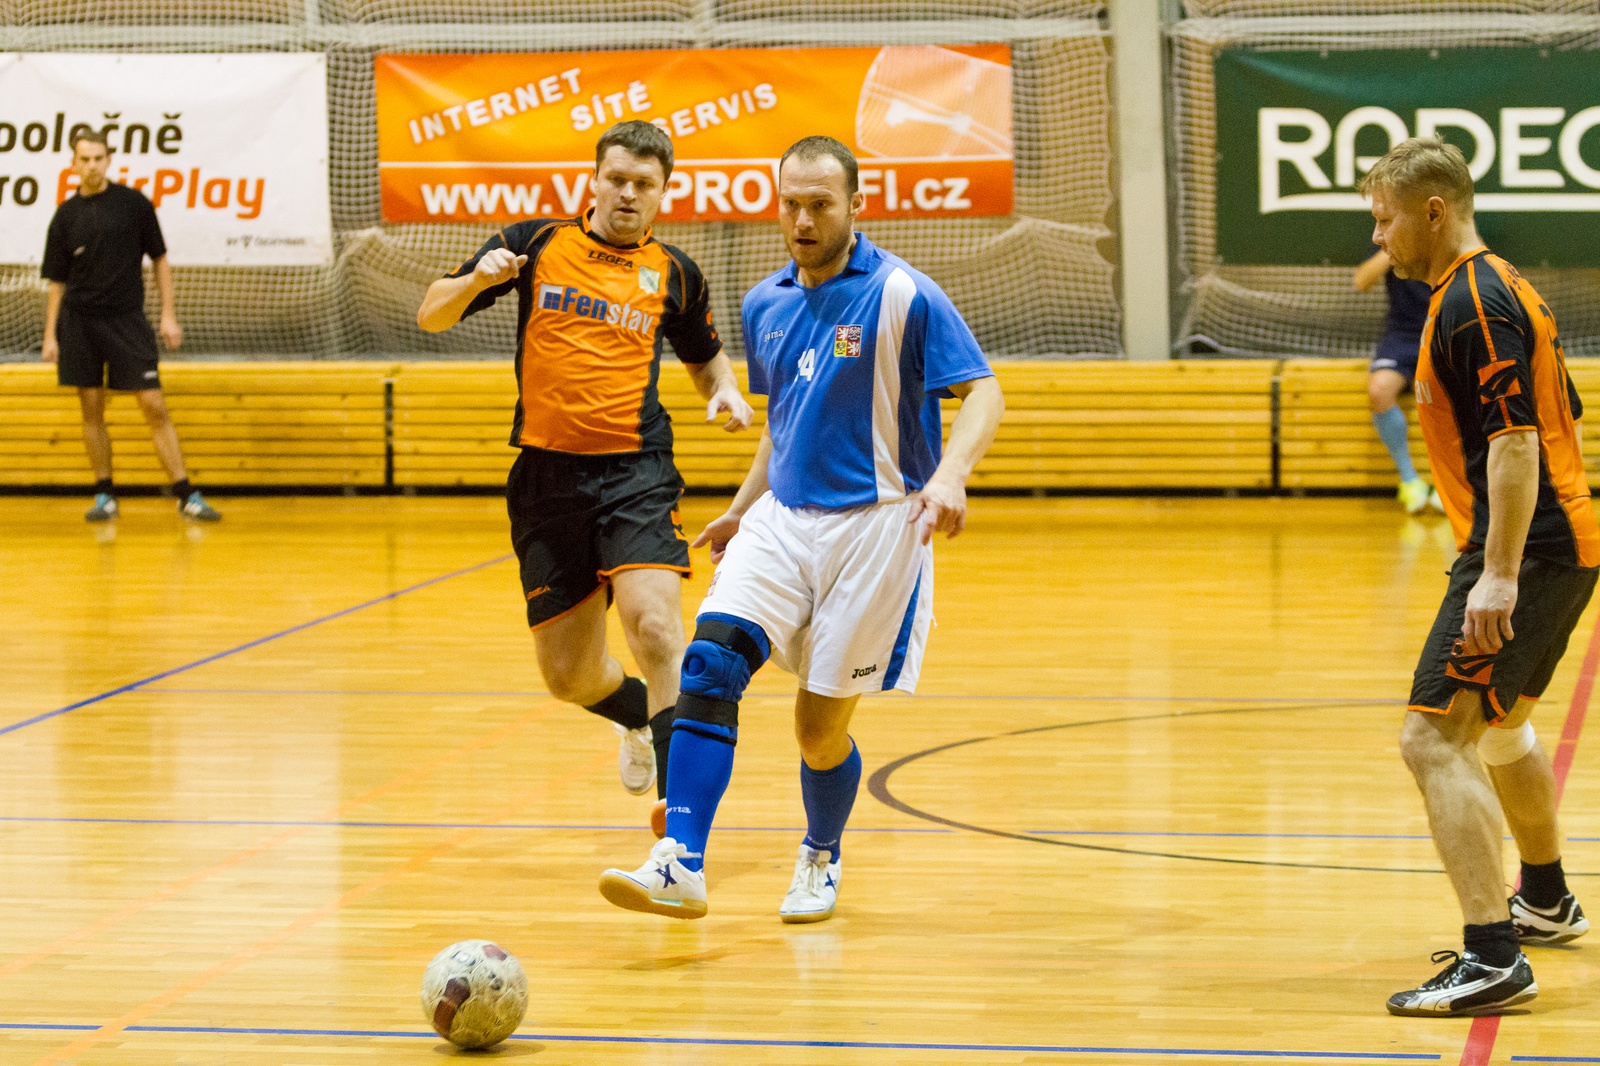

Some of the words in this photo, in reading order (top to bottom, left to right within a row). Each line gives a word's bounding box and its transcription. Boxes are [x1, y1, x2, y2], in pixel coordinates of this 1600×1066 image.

[409, 67, 582, 144] INTERNET
[570, 79, 652, 132] SÍTĚ
[650, 83, 777, 137] SERVIS
[588, 249, 634, 269] LEGEA
[561, 286, 655, 336] Fenstav
